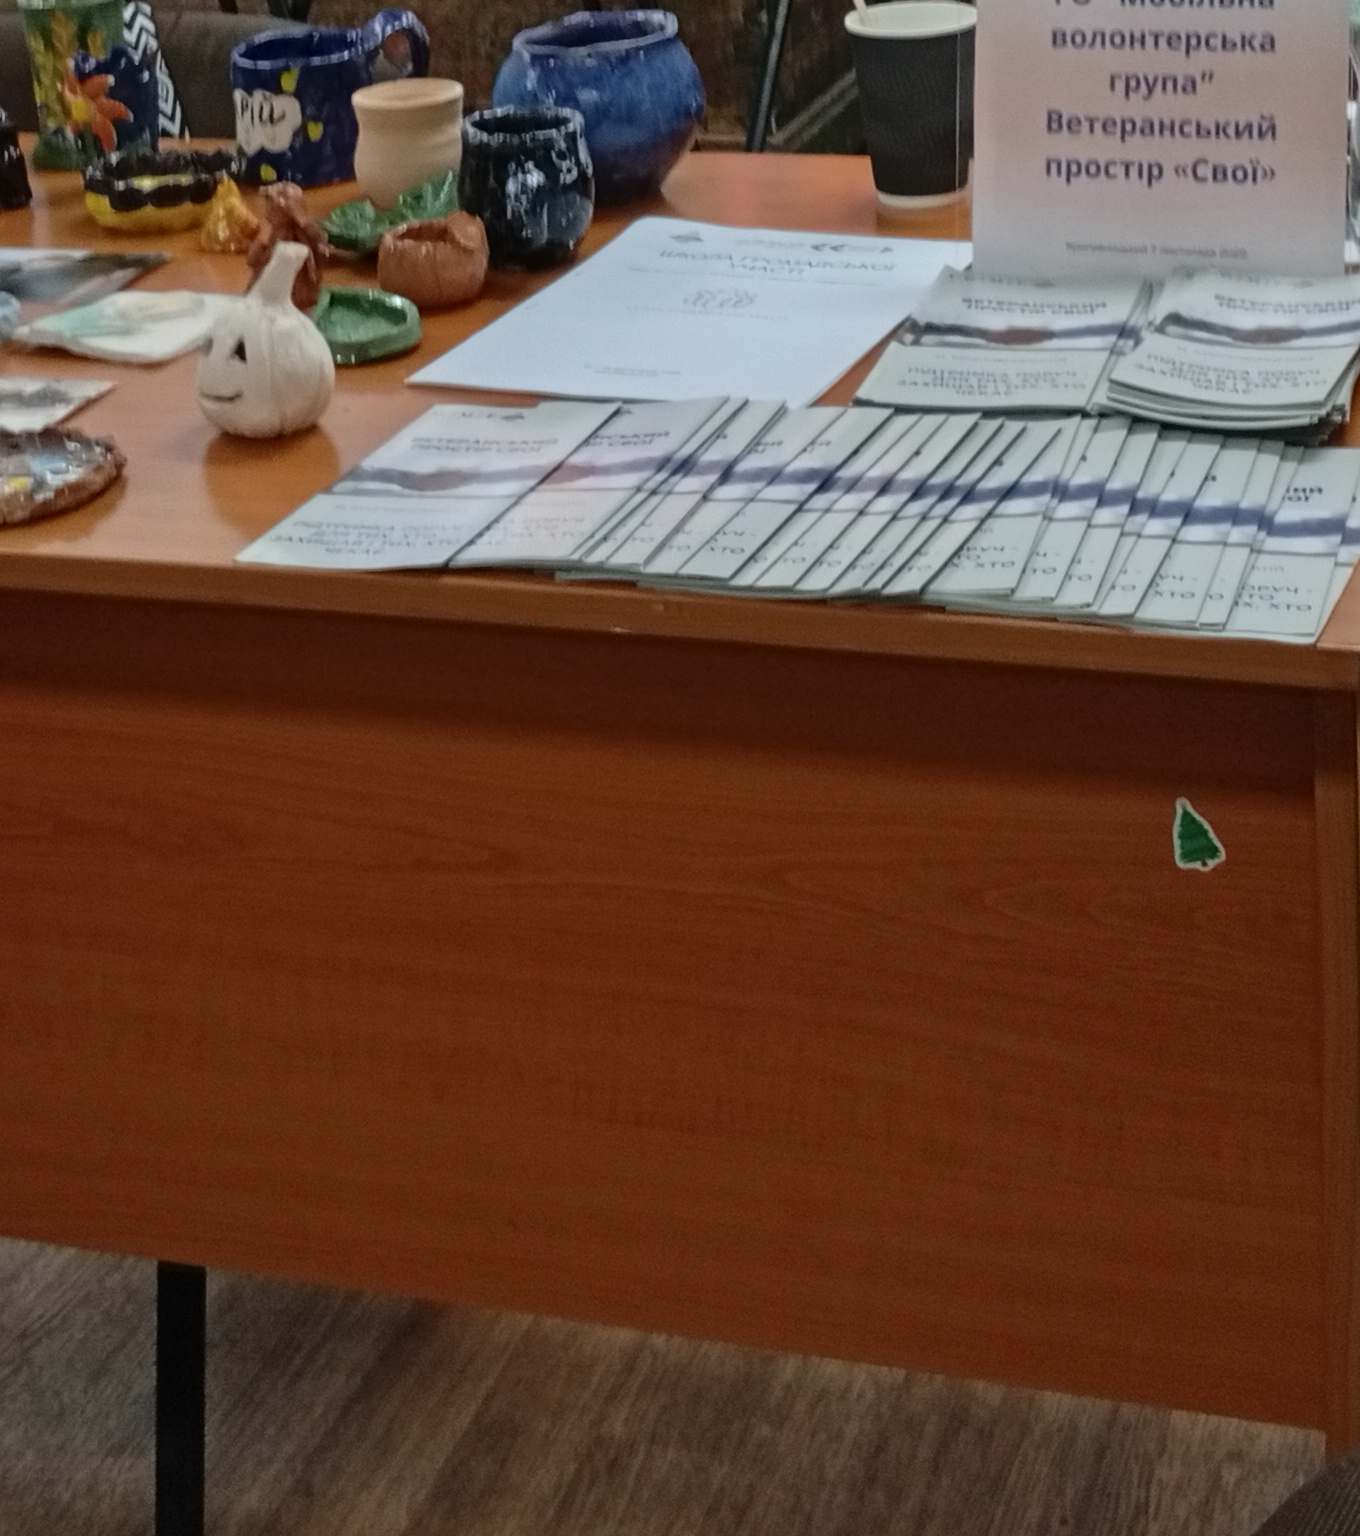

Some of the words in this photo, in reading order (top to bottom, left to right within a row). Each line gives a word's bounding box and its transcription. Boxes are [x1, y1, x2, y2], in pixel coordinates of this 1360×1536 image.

[1050, 27, 1277, 59] волонтерська
[1108, 69, 1215, 102] група"
[1045, 108, 1278, 144] Ветеранський
[1044, 155, 1165, 189] простір
[1173, 158, 1277, 186] «Свої»
